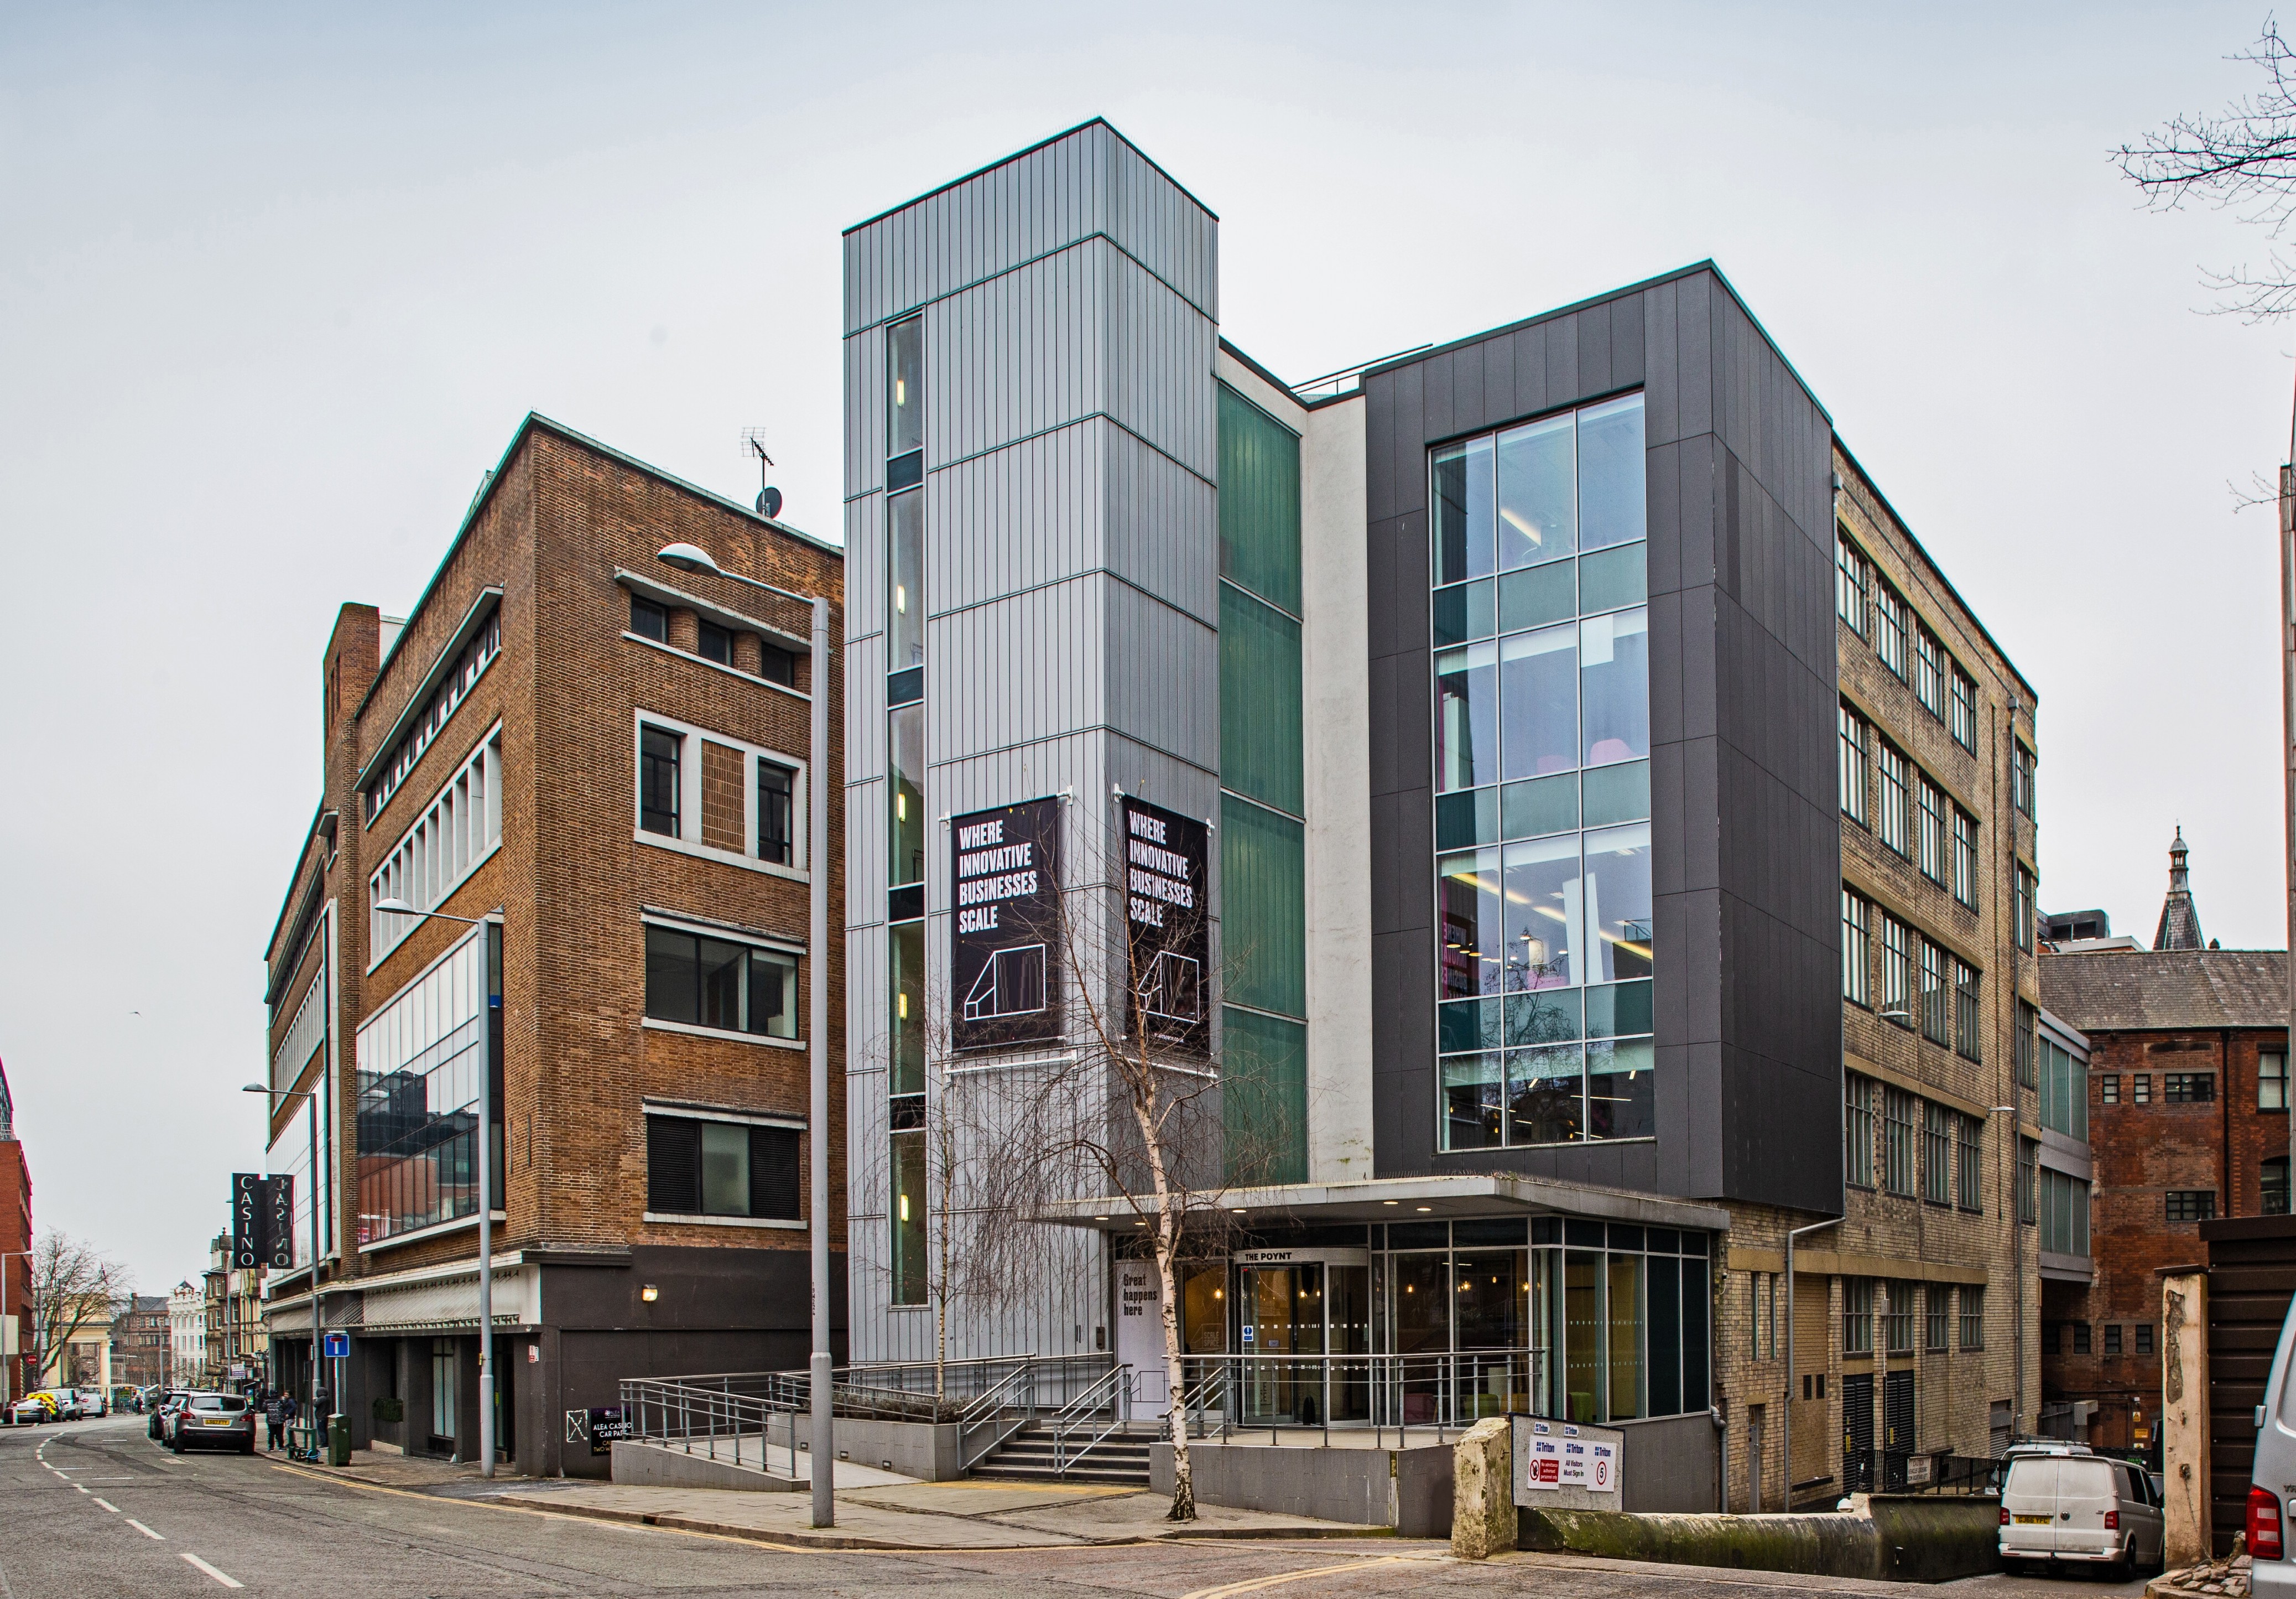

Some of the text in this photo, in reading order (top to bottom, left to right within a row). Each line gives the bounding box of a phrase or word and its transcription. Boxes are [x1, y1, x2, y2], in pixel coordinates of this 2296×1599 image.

[959, 819, 1003, 850] WHERE
[1129, 809, 1167, 845] WHERE
[959, 842, 1032, 879] INNOVATIVE
[1129, 839, 1189, 880] INNOVATIVE
[959, 870, 1038, 906] BUSINESSES
[1129, 867, 1193, 909] BUSINESSES
[959, 905, 998, 935] SCALE
[1129, 896, 1163, 928] SCALE
[241, 1176, 254, 1266] CASINO
[1261, 1252, 1292, 1260] POYNT
[1123, 1273, 1147, 1286] Great
[1123, 1288, 1158, 1304] happens
[1123, 1303, 1143, 1316] here
[1539, 1424, 1548, 1432] Triton
[1568, 1426, 1577, 1435] Triton
[1541, 1442, 1555, 1453] Triton
[1571, 1444, 1584, 1454] Triton
[1599, 1447, 1611, 1457] Triton
[1600, 1467, 1604, 1478] 5
